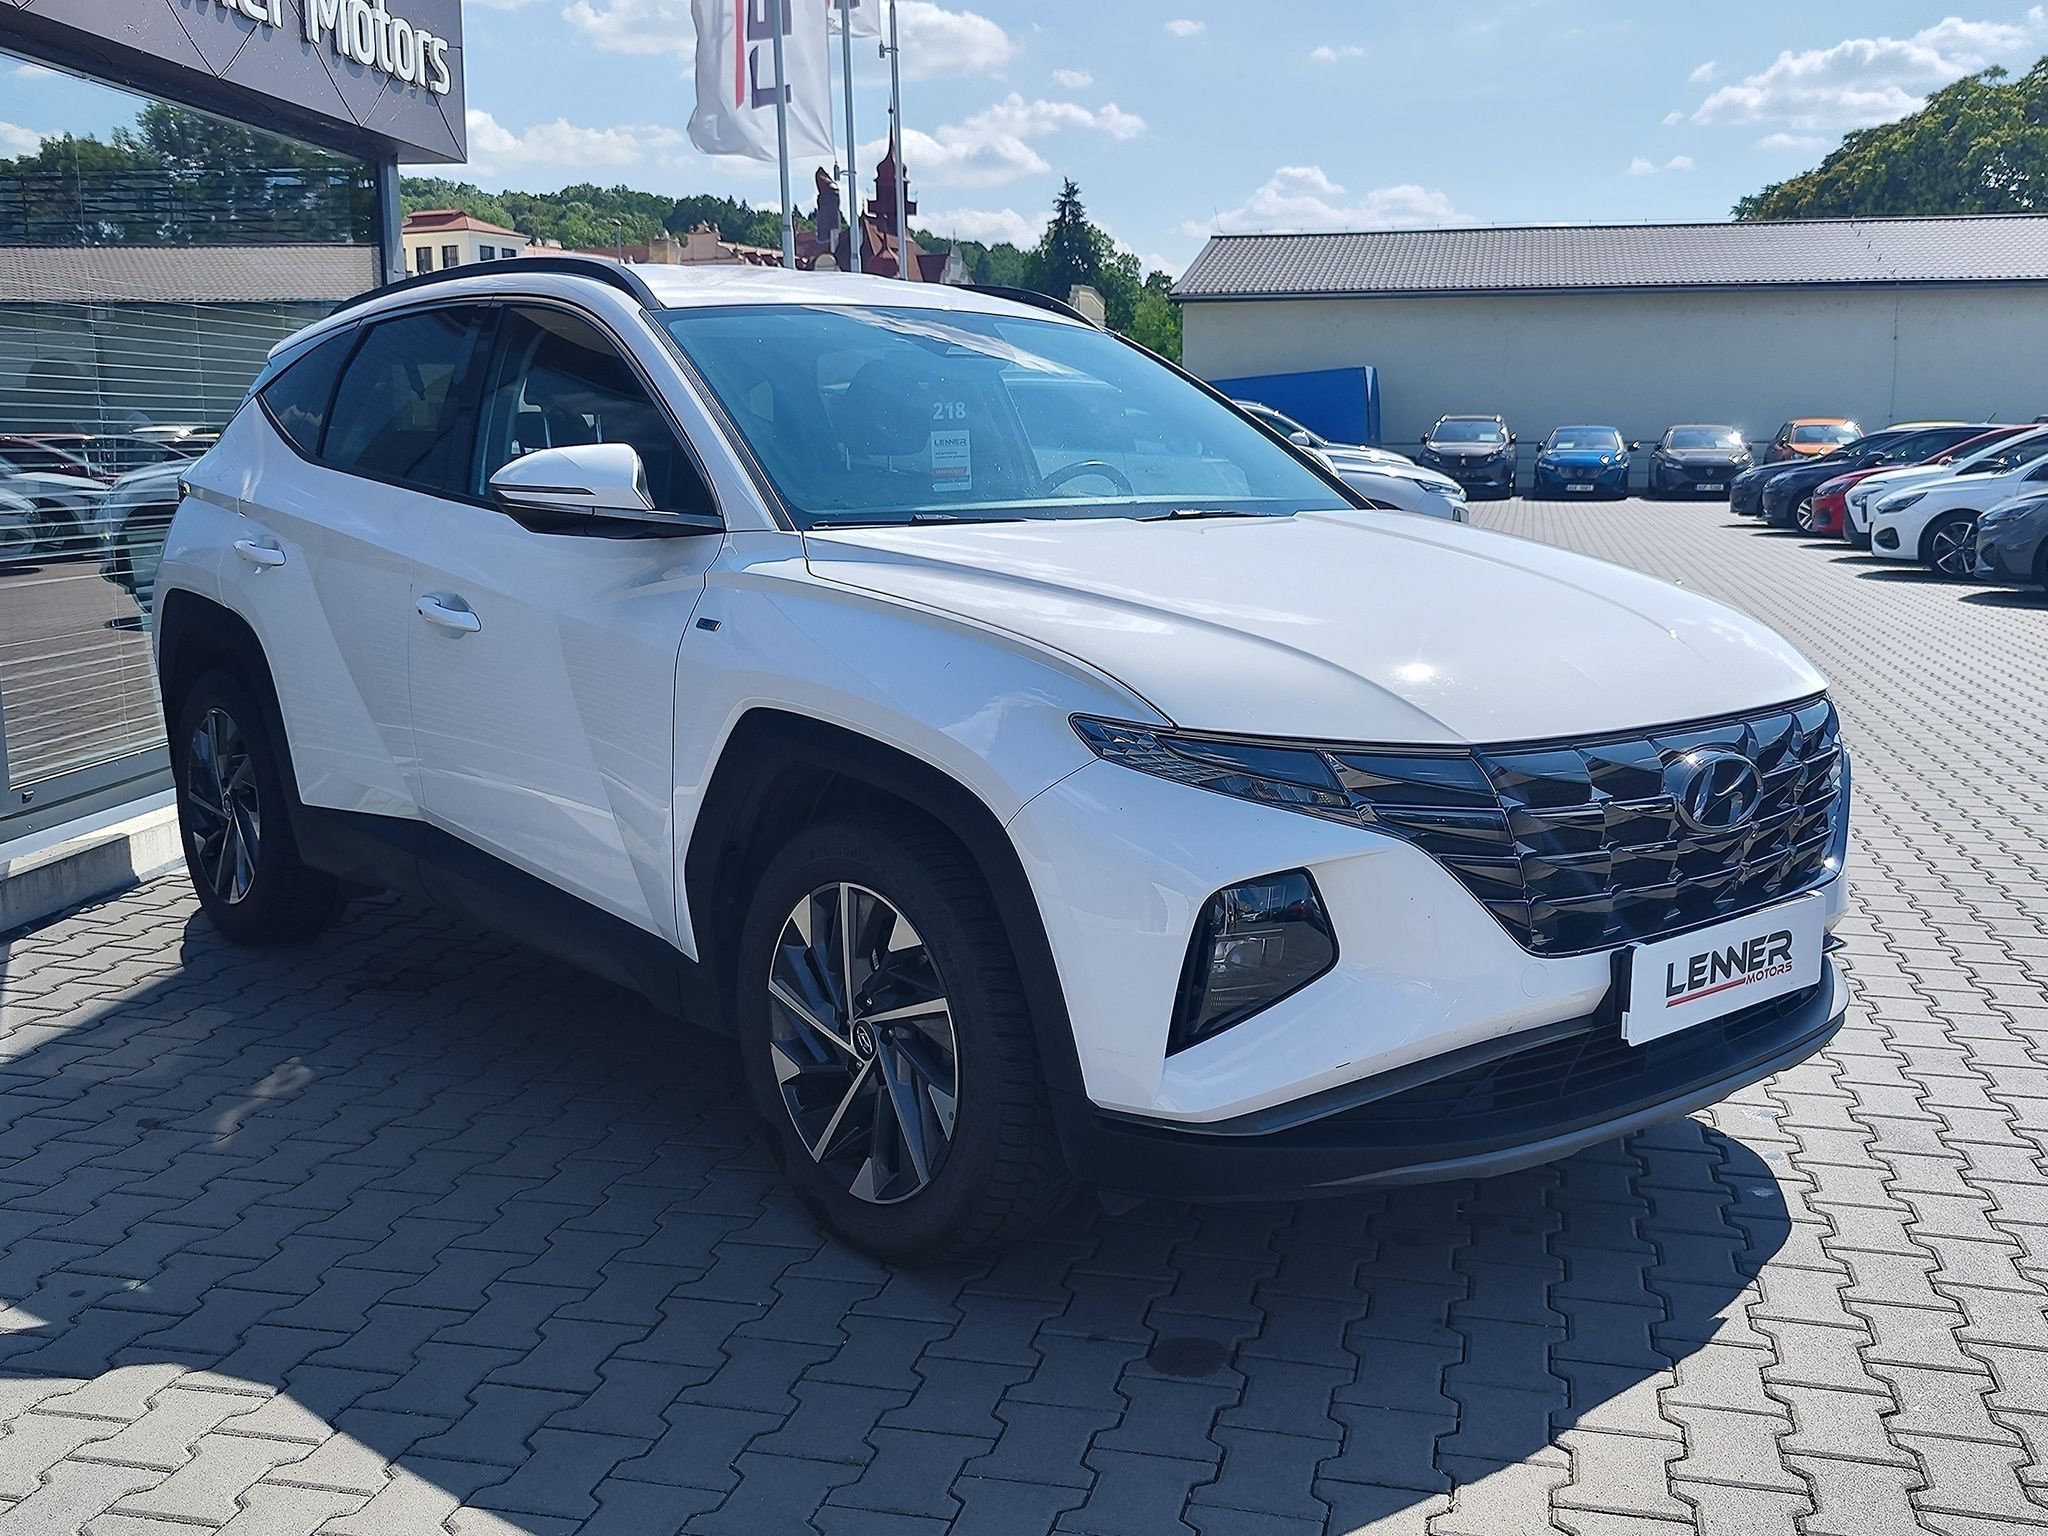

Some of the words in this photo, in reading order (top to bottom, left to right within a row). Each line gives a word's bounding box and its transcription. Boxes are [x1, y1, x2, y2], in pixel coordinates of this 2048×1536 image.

[932, 401, 967, 420] 218
[1666, 929, 1793, 998] LENNER
[1746, 961, 1793, 985] MOTORS
